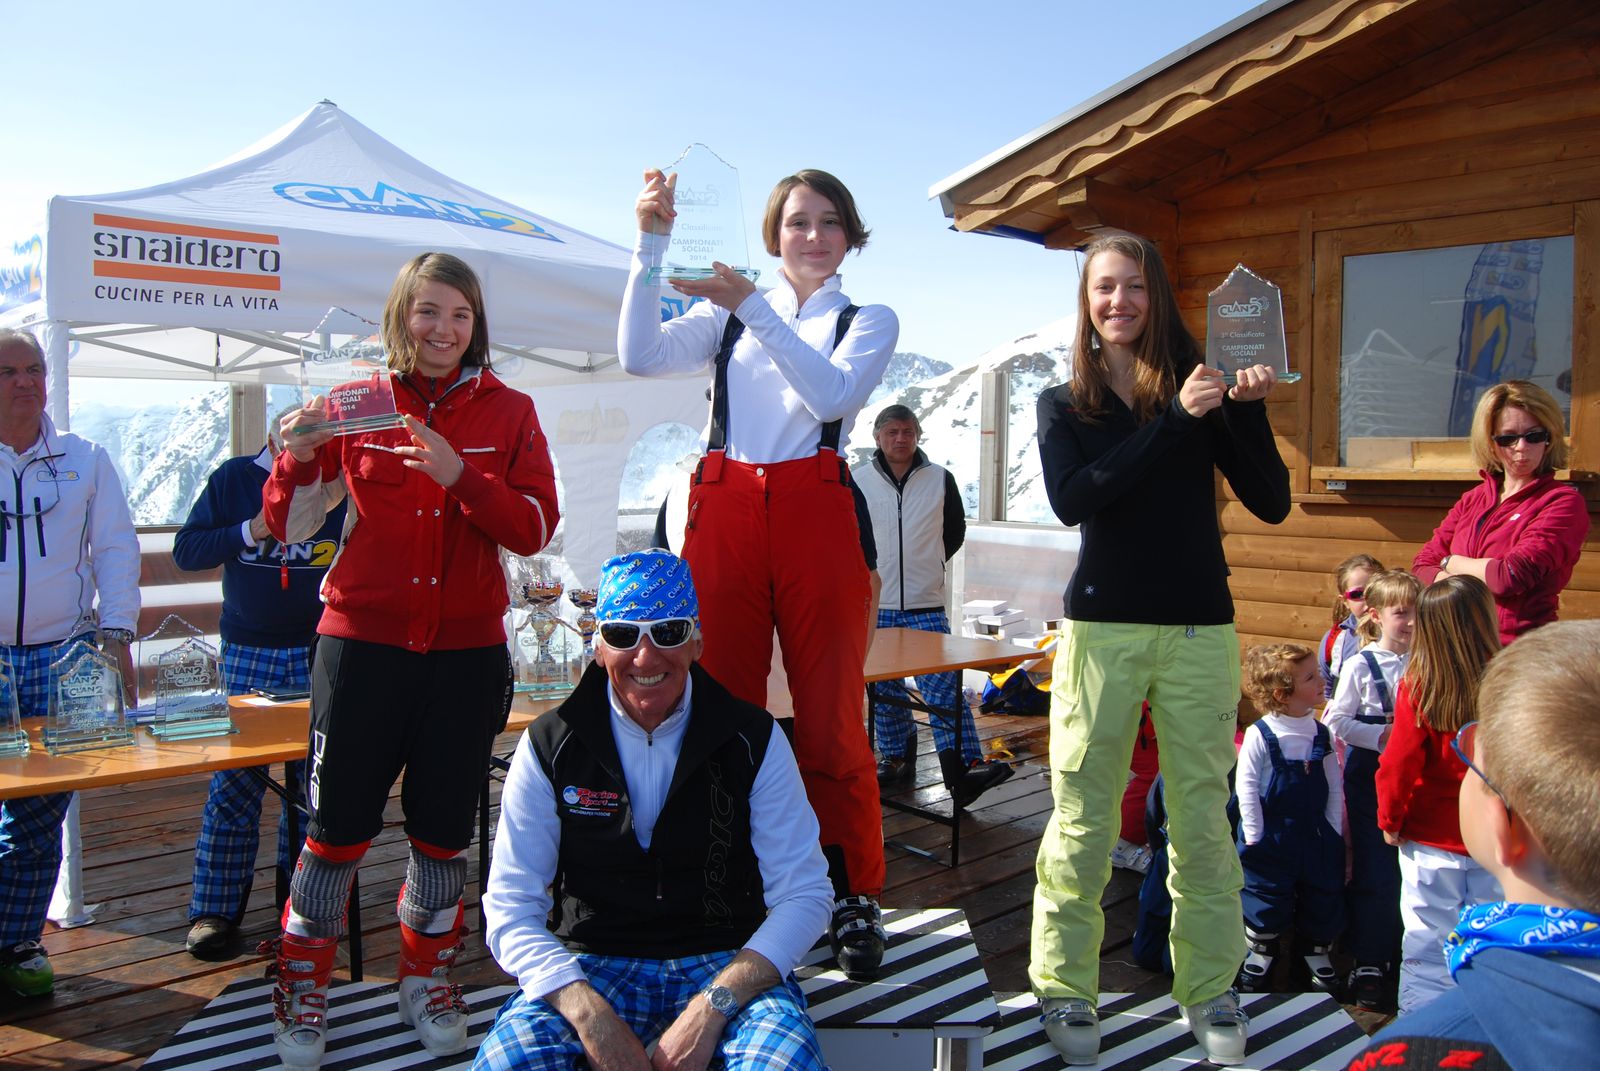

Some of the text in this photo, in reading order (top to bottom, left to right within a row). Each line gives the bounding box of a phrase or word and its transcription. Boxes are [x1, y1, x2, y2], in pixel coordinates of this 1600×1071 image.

[93, 231, 281, 273] snaidero
[94, 285, 280, 311] CUCINE PER LA VITA
[1218, 301, 1260, 316] CLAN2
[330, 396, 361, 405] SOCIALI
